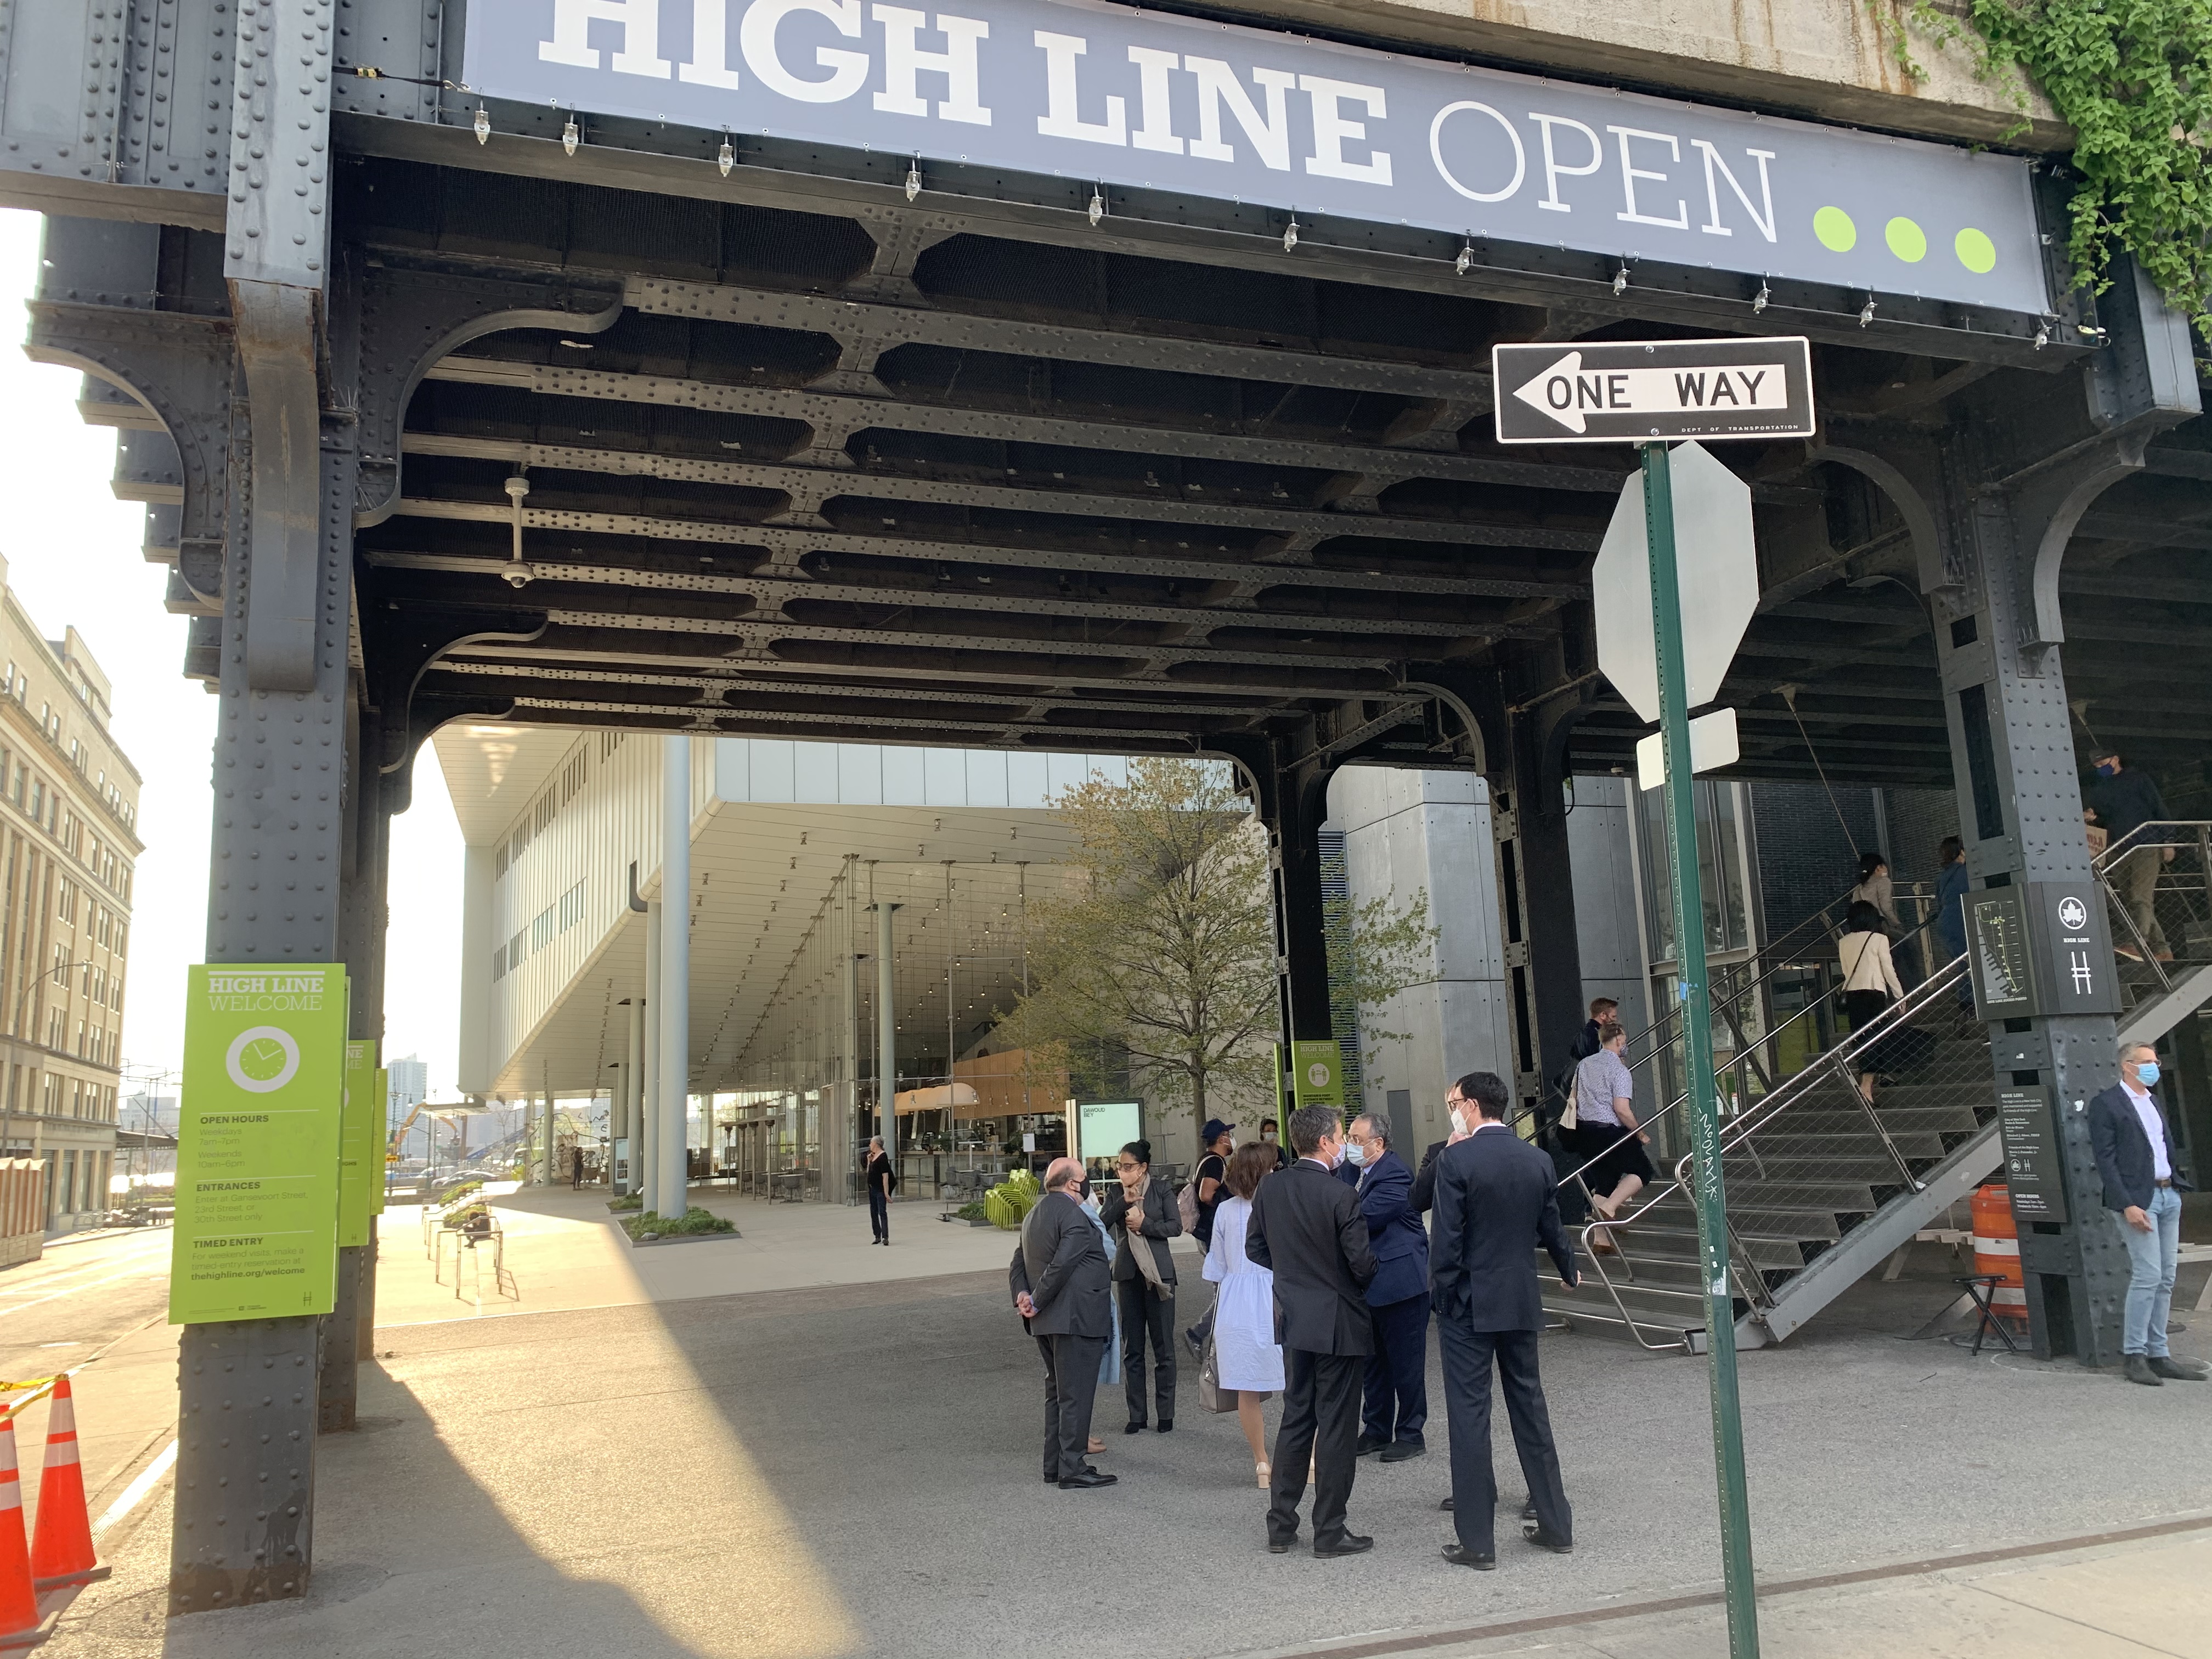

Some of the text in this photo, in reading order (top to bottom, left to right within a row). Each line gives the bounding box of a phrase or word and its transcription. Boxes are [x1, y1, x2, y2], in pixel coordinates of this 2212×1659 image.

[539, 0, 1778, 243] HIGH LINE OPEN
[1547, 370, 1767, 410] ONE WAY
[208, 978, 324, 993] HIGH LINE
[208, 995, 323, 1011] WELCOME
[200, 1115, 269, 1124] OPEN HOURS
[199, 1127, 242, 1136] Weekdays
[198, 1150, 242, 1158] Weekends
[196, 1182, 261, 1192] ENTRANCES
[231, 1193, 279, 1202] Gansevoort
[195, 1205, 215, 1214] 23rd
[216, 1204, 244, 1212] Street,
[194, 1212, 262, 1223] 30th Street only
[193, 1237, 263, 1248] TIMED ENTRY
[208, 1250, 247, 1259] weekend
[274, 1247, 297, 1255] make
[192, 1261, 242, 1270] timed-entry
[244, 1259, 291, 1267] reservation
[191, 1267, 305, 1280] thehighline.org/welcome
